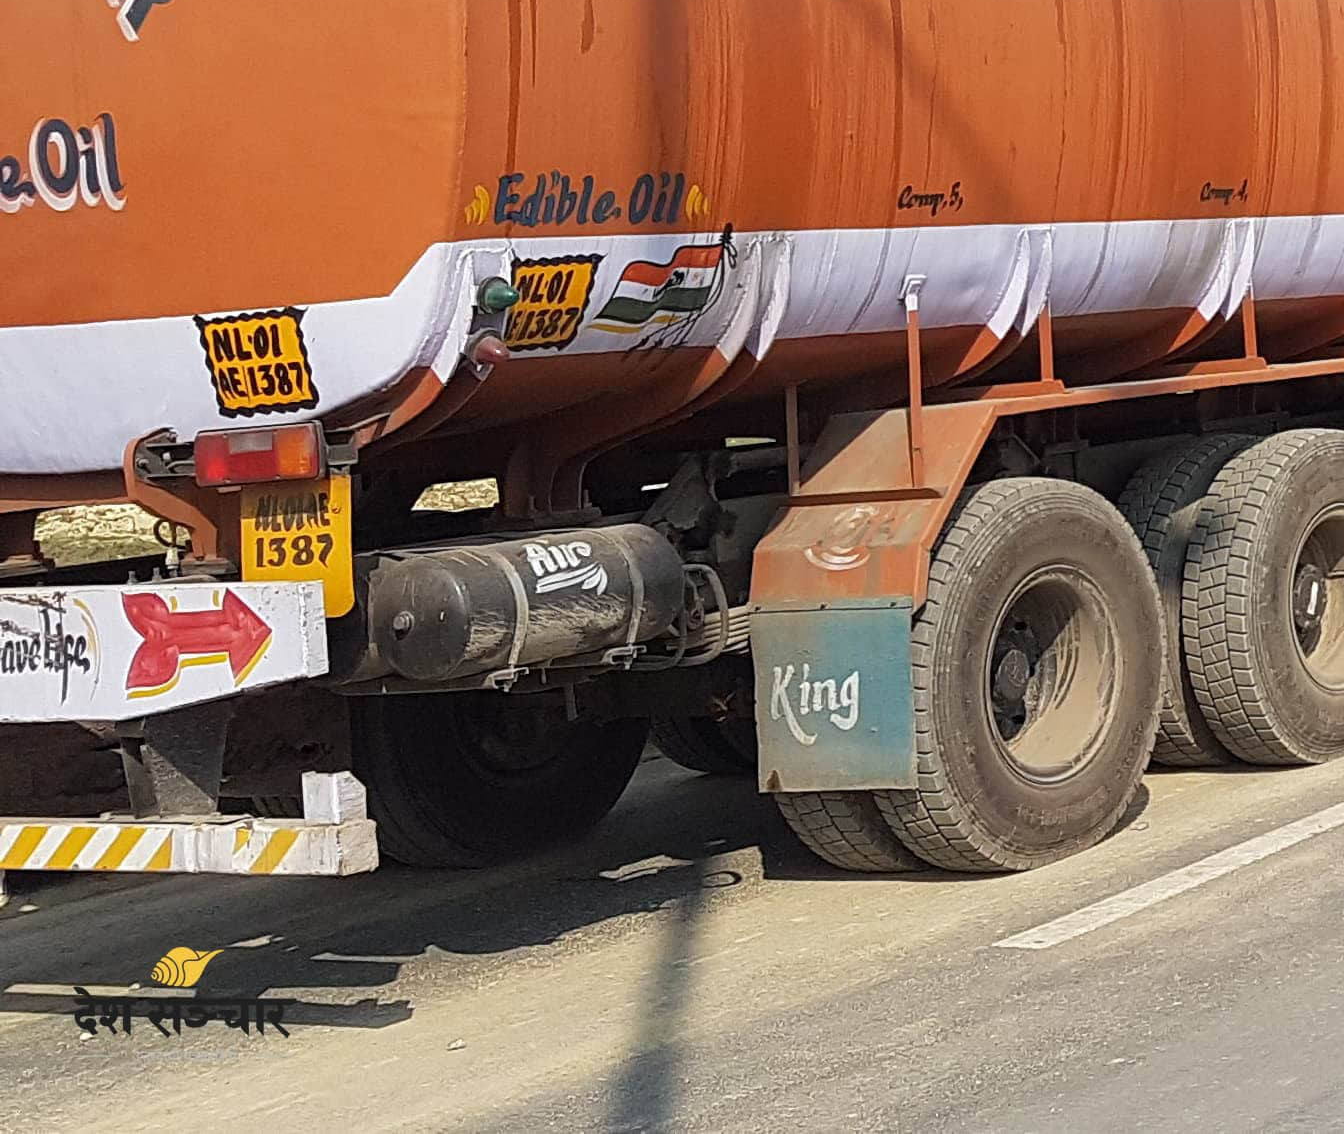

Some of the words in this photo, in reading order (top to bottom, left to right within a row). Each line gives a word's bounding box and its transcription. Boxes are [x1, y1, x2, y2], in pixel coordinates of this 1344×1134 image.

[29, 112, 128, 212] Oil
[628, 172, 685, 226] Oil
[255, 533, 335, 568] 1387
[522, 541, 592, 577] Air
[770, 663, 861, 746] King
